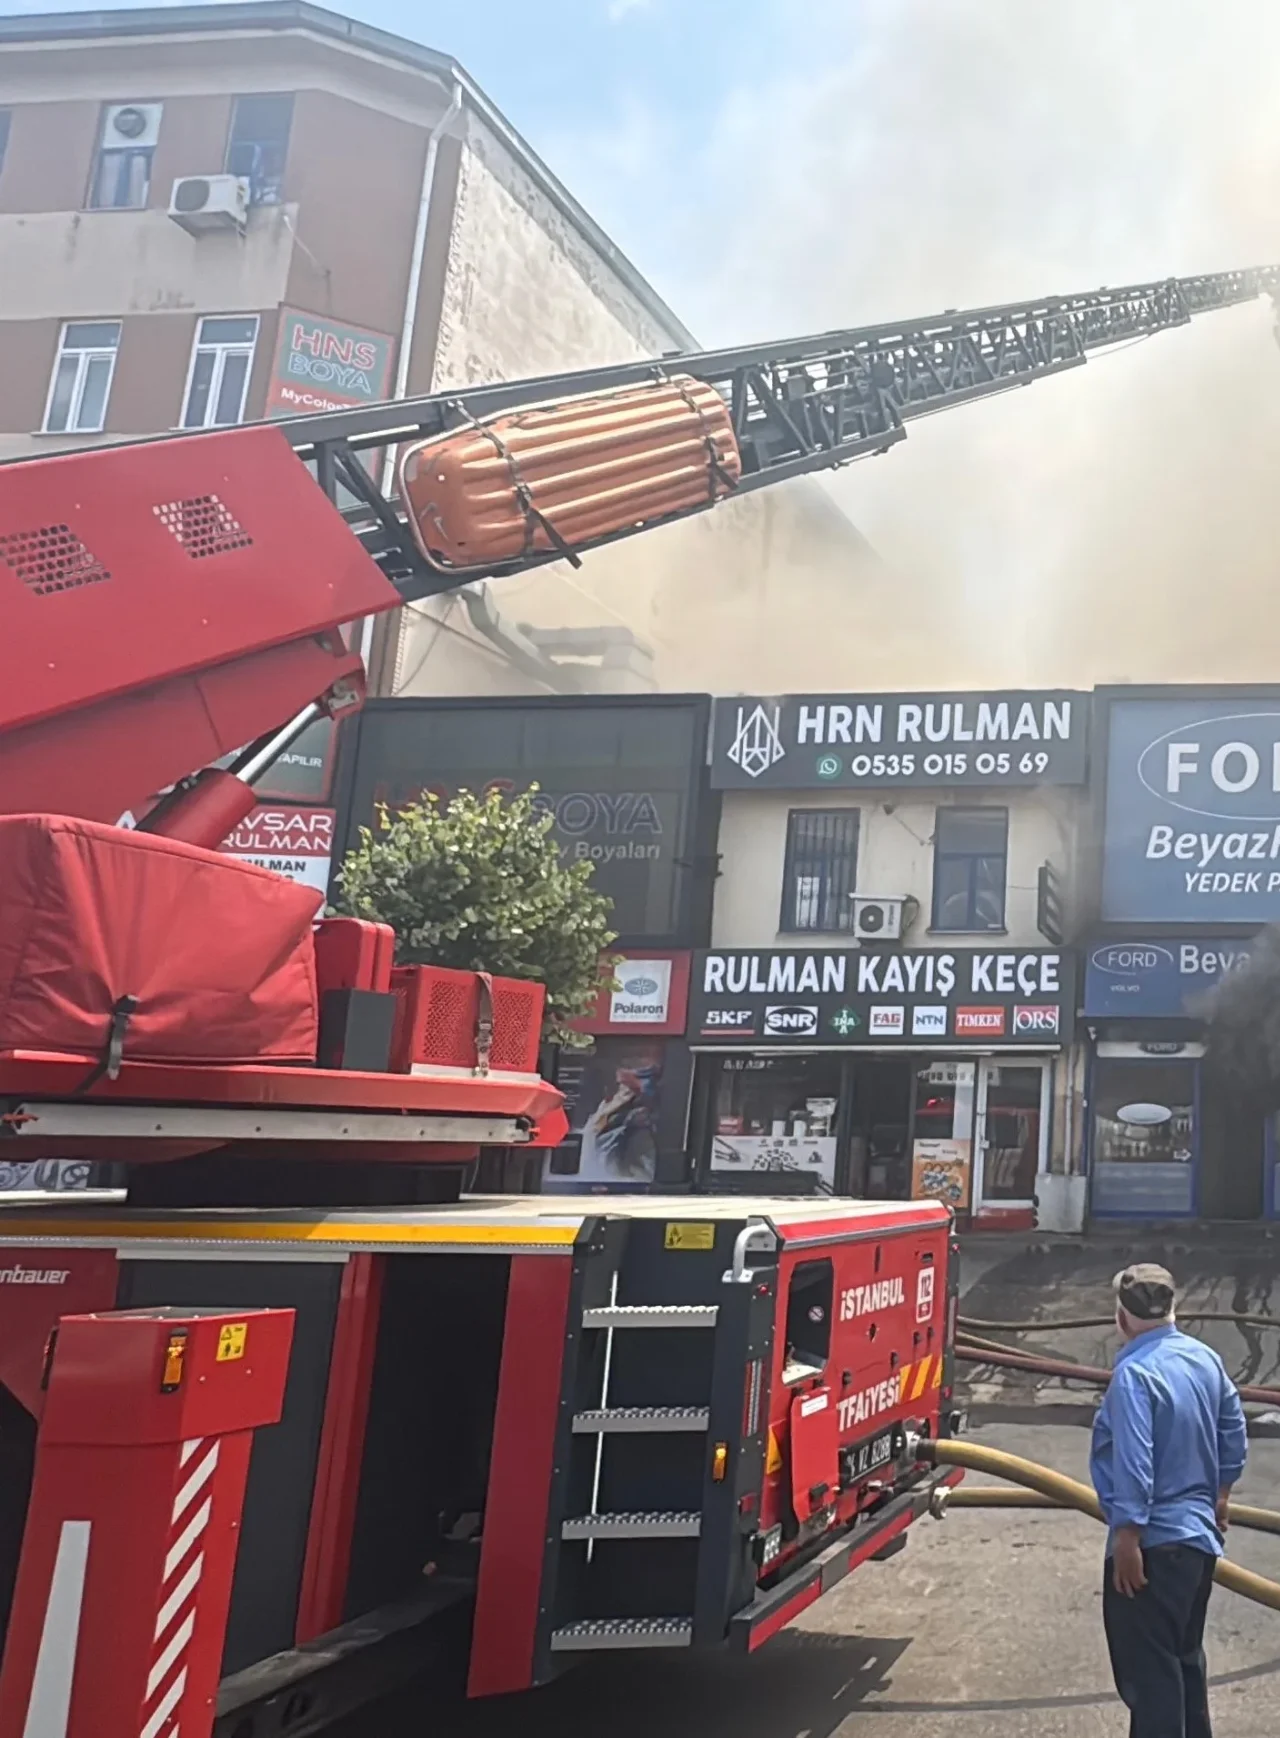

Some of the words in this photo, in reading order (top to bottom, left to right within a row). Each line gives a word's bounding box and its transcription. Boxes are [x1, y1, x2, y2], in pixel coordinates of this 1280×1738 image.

[291, 323, 377, 370] HNS
[288, 352, 372, 395] BOYA
[797, 705, 883, 744] HRN
[897, 701, 1071, 743] RULMAN
[278, 752, 322, 768] APILIR
[851, 754, 916, 777] 0535
[923, 754, 967, 776] 015
[975, 753, 1010, 775] 05
[1019, 752, 1049, 774] 69
[237, 812, 332, 835] VŞAR
[574, 841, 661, 863] Boyaları
[1185, 872, 1262, 893] YEDEK
[1107, 951, 1158, 968] FORD
[703, 955, 846, 993] RULMAN
[857, 954, 955, 997] KAYIŞ
[971, 954, 1060, 997] KEÇE
[613, 1002, 664, 1014] Polaron
[705, 1010, 753, 1025] SKF
[767, 1013, 815, 1028] SNR
[873, 1012, 901, 1024] FAG
[915, 1014, 944, 1026] NTN
[956, 1013, 1002, 1027] TIMKEN
[1016, 1010, 1057, 1030] ORS
[840, 1277, 905, 1322] İSTANBUL
[835, 1375, 902, 1432] TFAİYESİ
